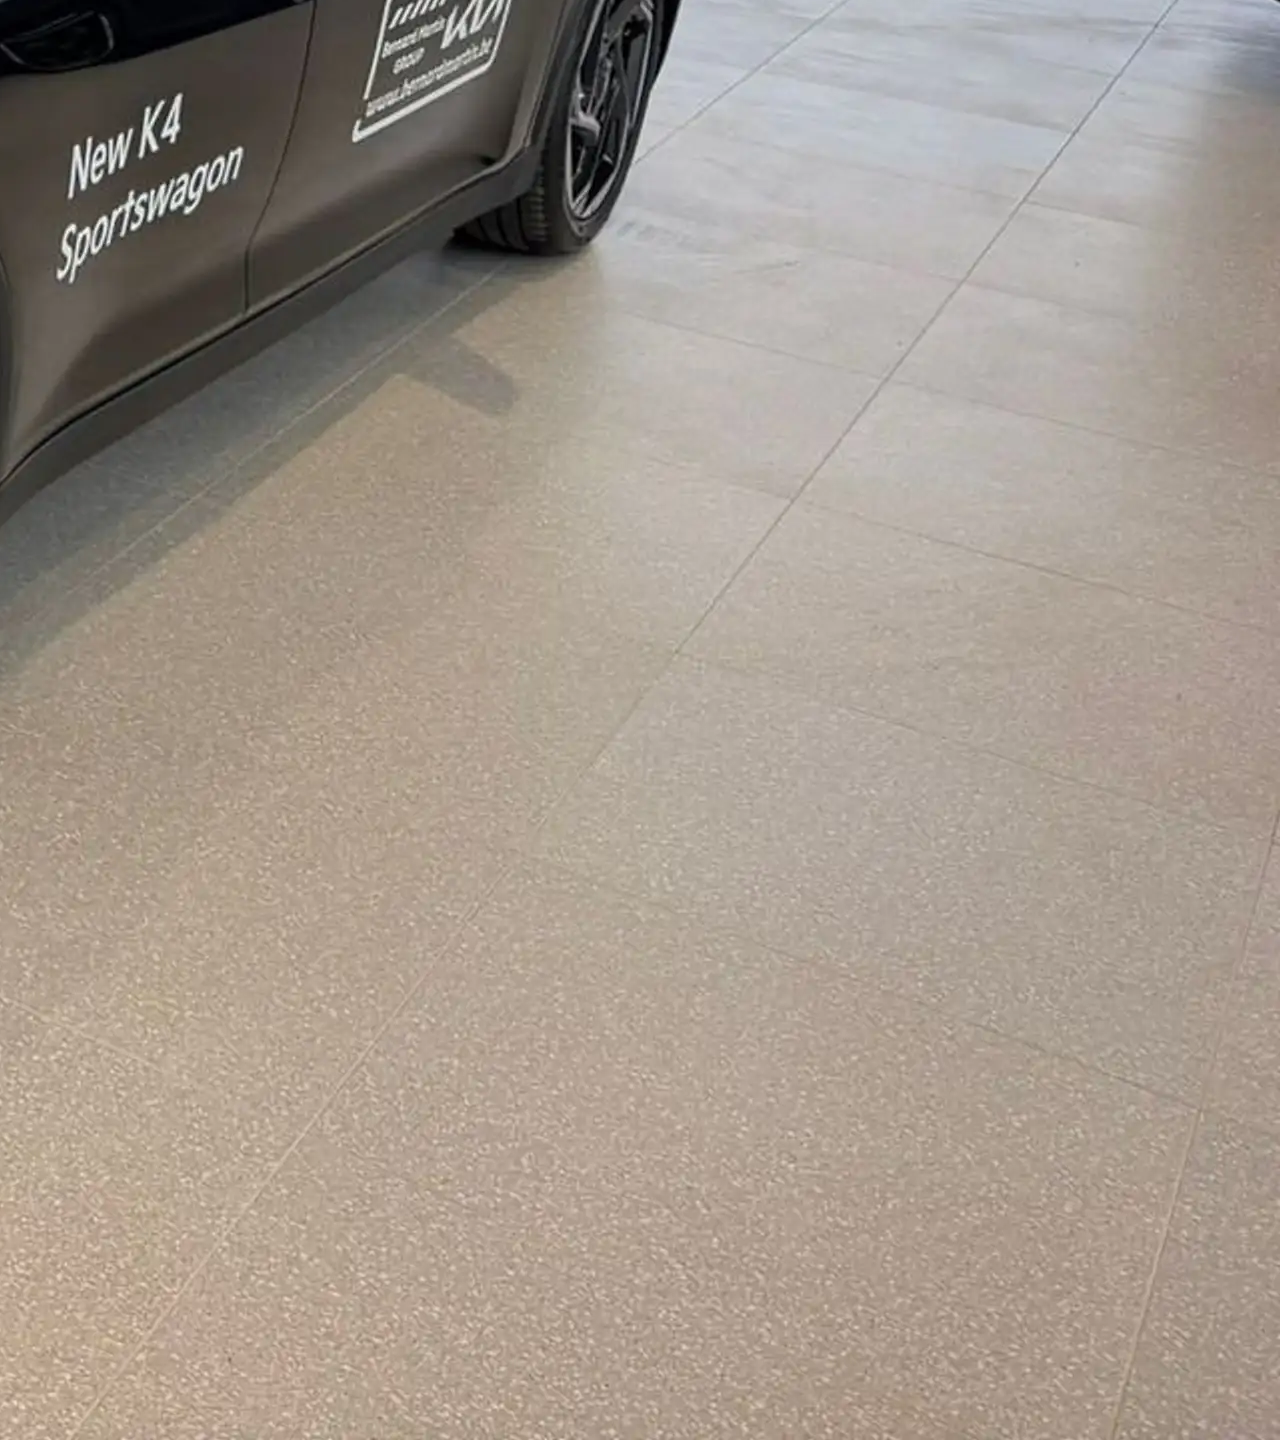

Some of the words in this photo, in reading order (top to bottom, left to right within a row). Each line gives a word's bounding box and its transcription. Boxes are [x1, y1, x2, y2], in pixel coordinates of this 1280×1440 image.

[67, 127, 135, 201] New
[138, 91, 184, 160] K4
[55, 145, 245, 285] Sportswagon
